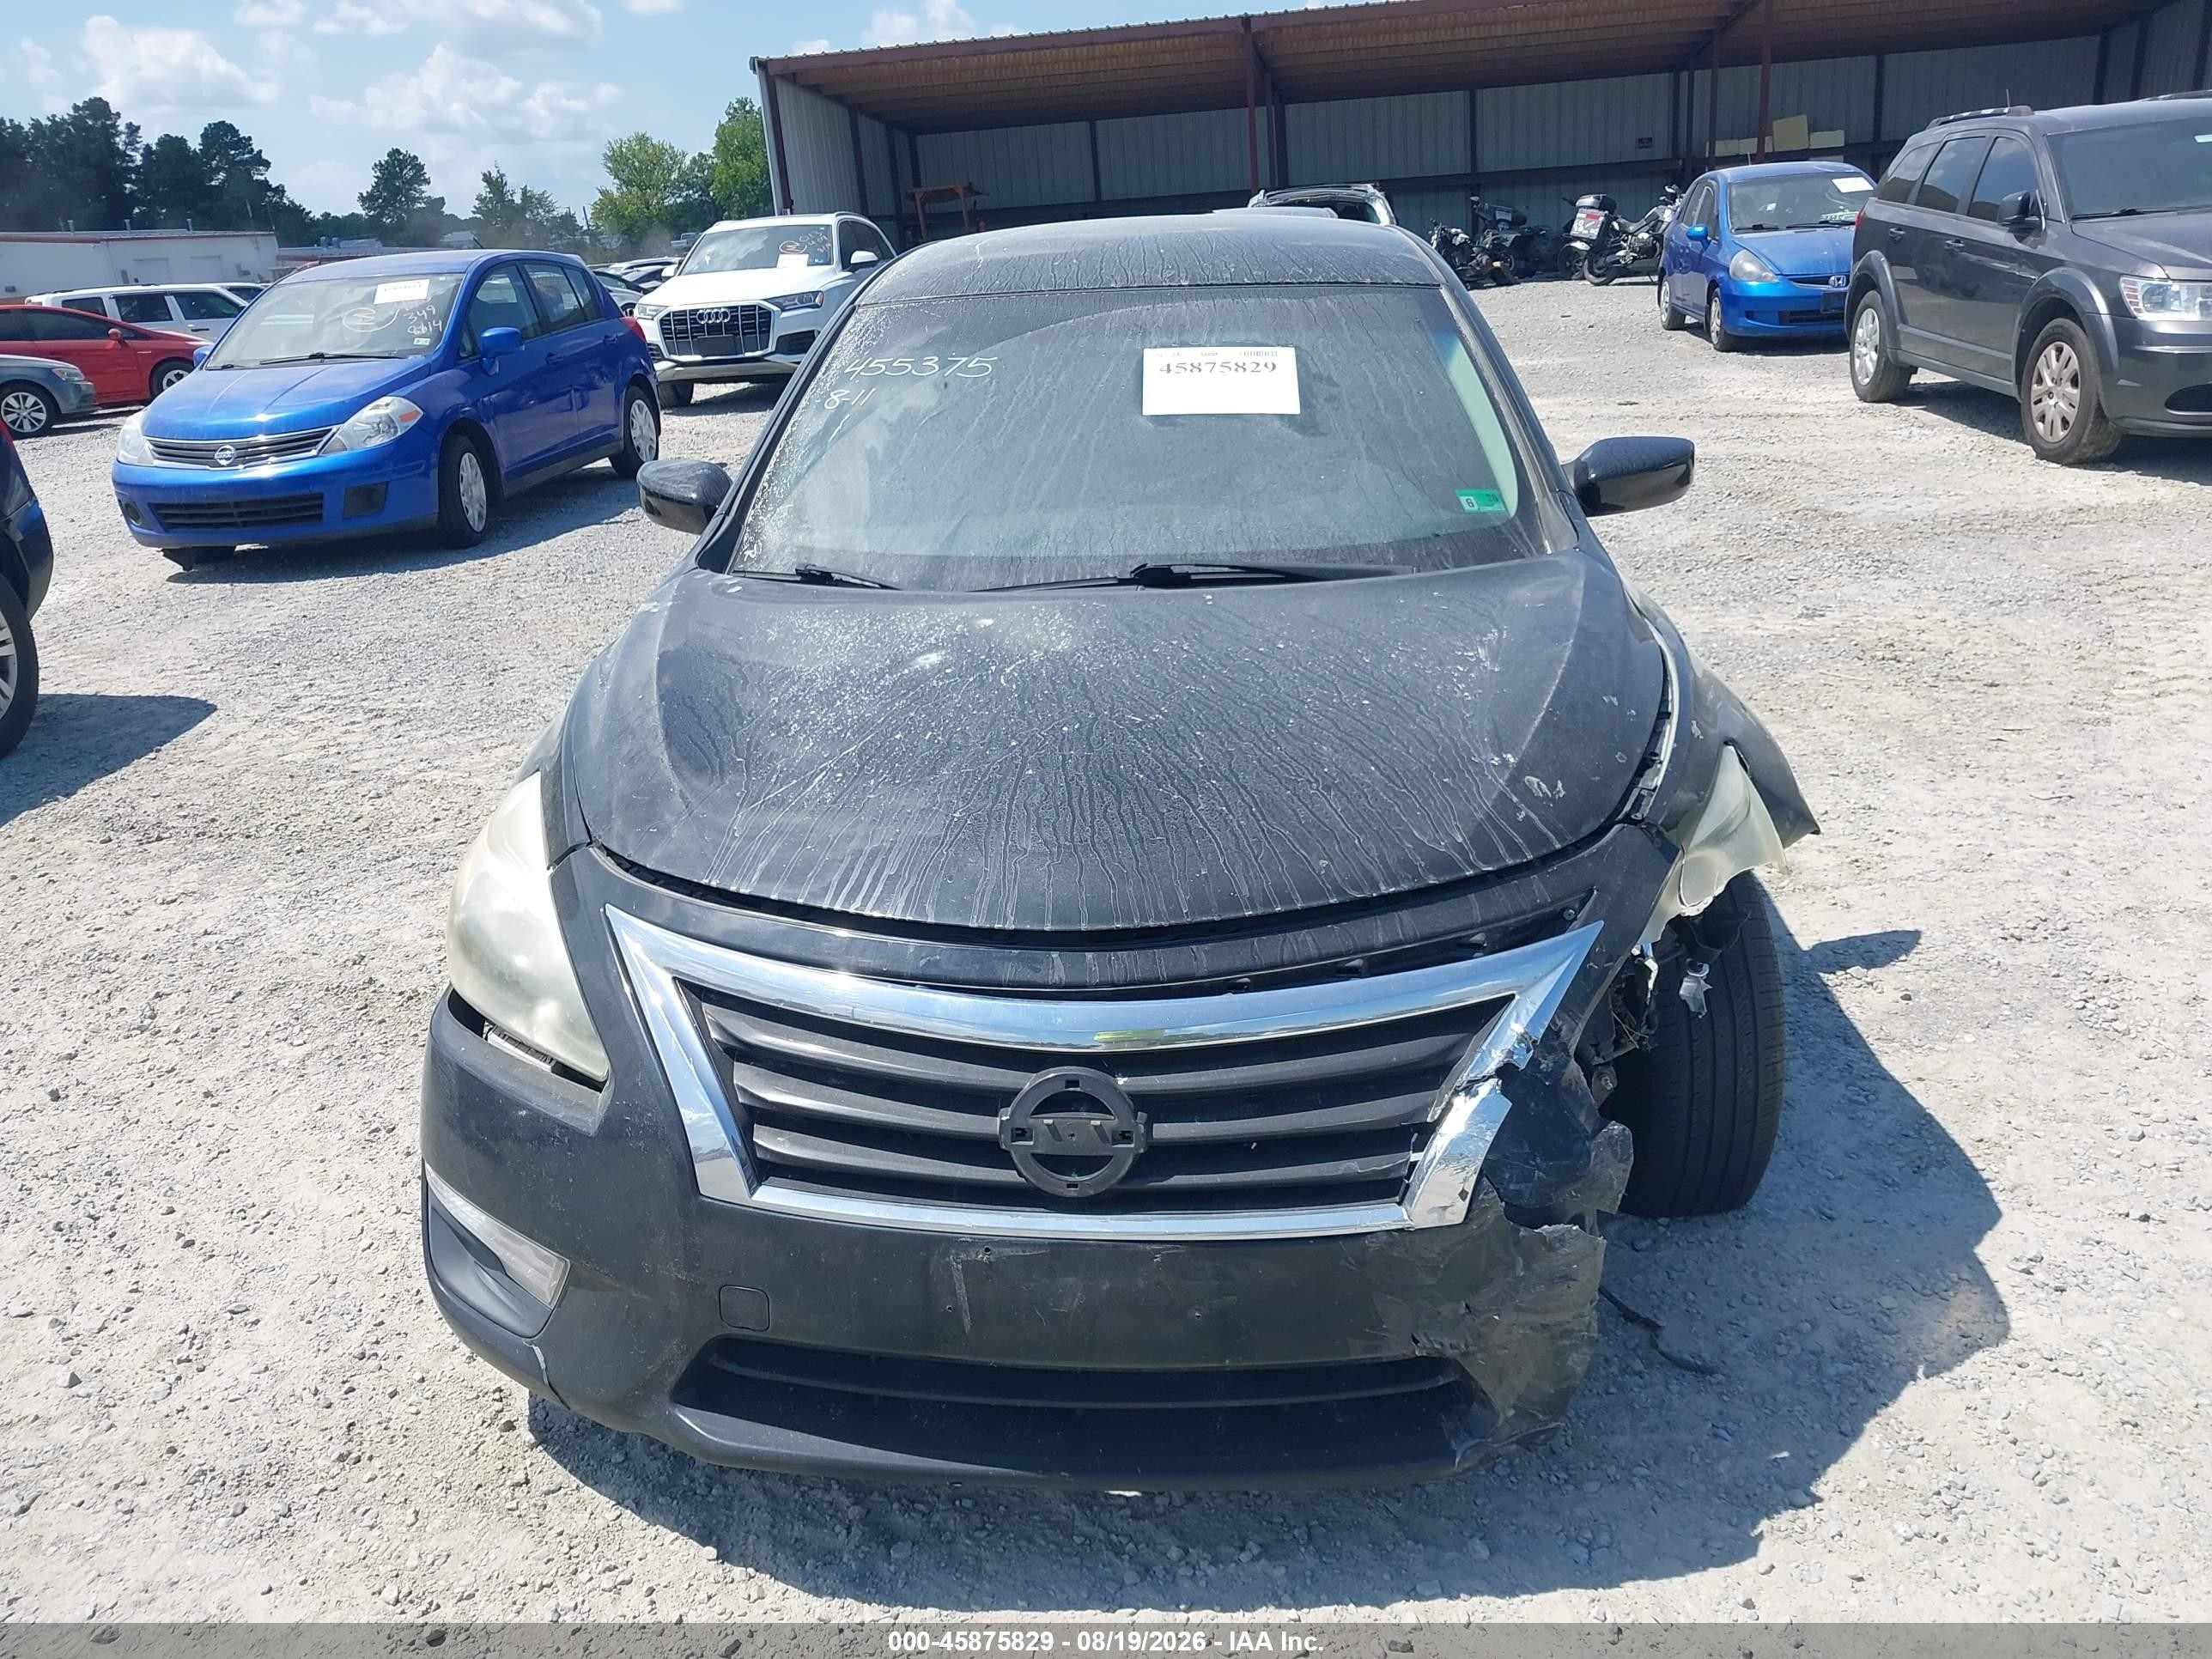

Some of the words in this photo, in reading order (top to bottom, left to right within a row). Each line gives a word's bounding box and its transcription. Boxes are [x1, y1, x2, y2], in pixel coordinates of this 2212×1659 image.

[844, 356, 998, 381] 455375
[1159, 362, 1277, 374] 45875829
[823, 387, 877, 410] 8-11
